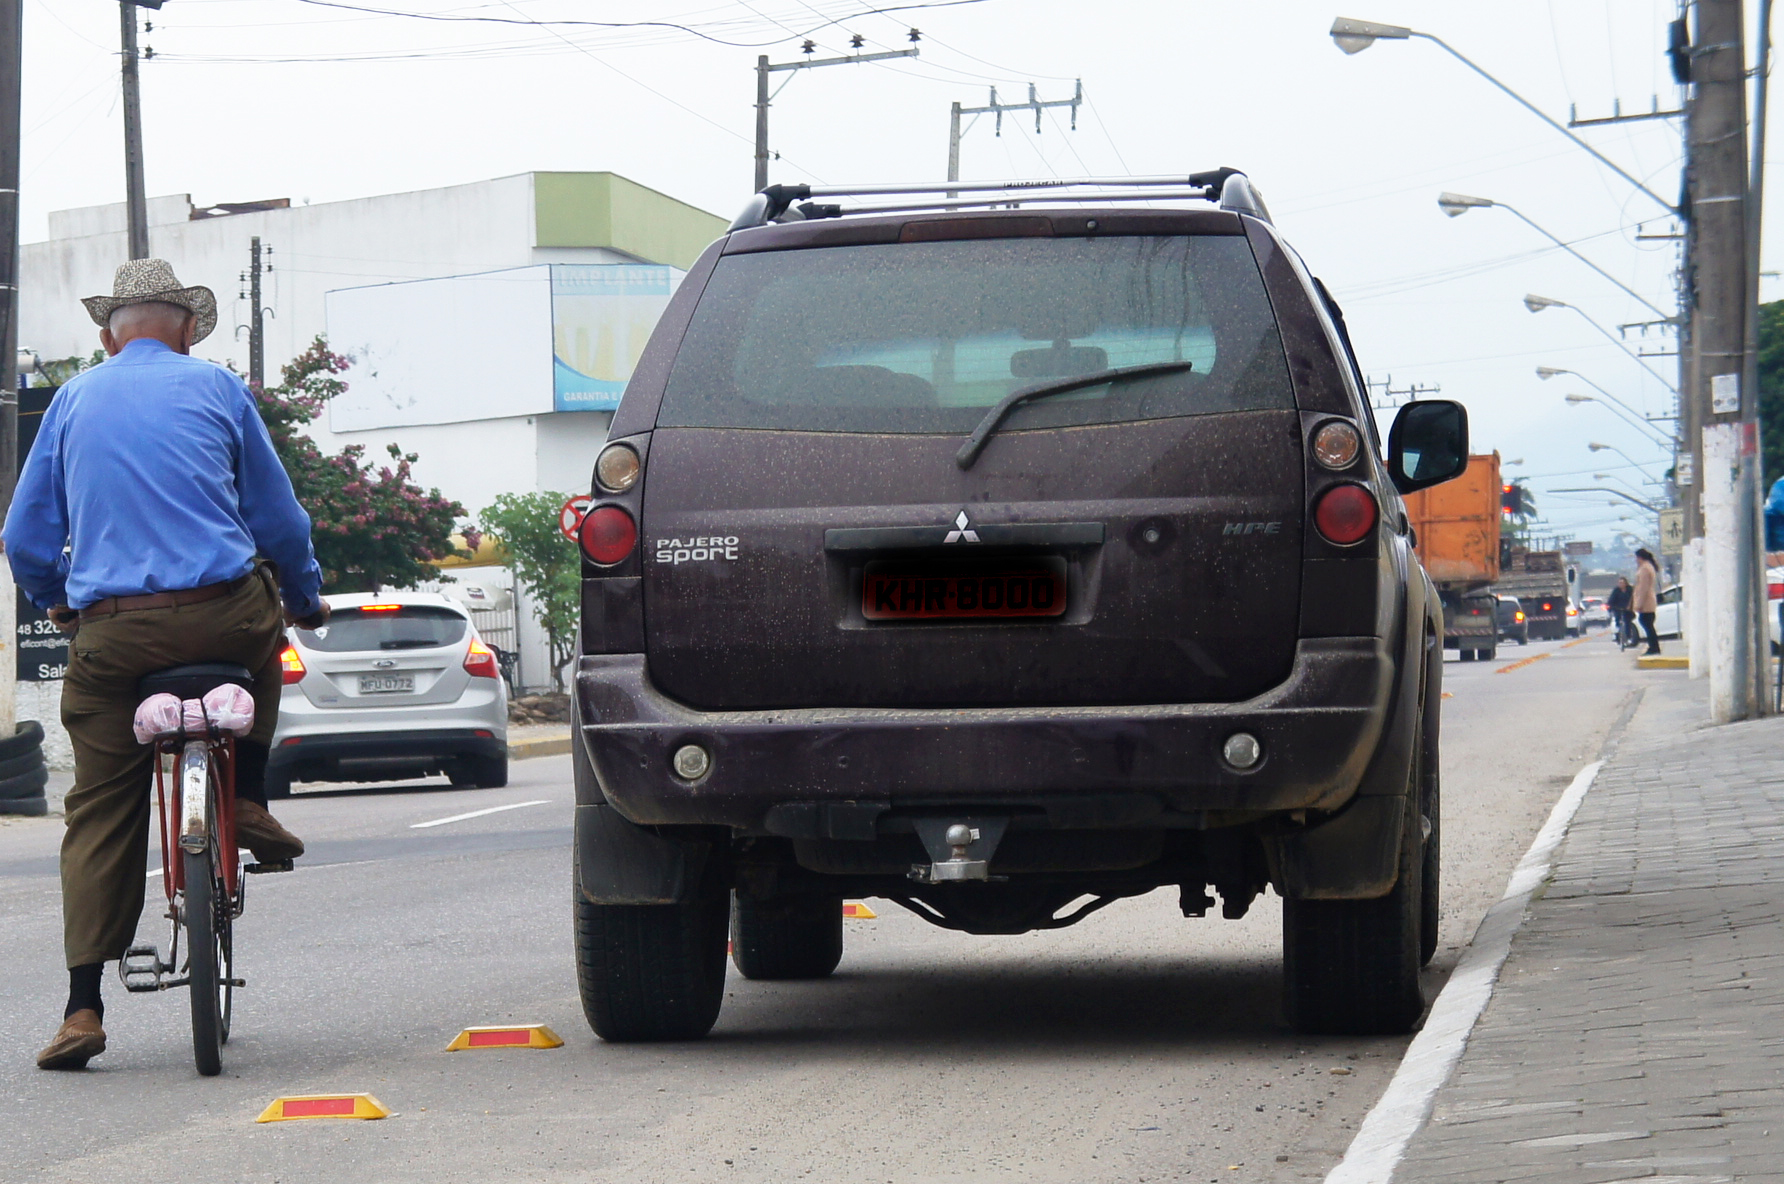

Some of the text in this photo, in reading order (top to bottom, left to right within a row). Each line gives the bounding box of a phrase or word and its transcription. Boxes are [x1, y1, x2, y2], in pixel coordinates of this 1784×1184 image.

[560, 269, 665, 287] IMPLANTE
[564, 391, 609, 401] GARANTIA
[1222, 522, 1282, 535] HPE
[657, 536, 739, 549] PAJERO
[656, 547, 739, 565] sport
[17, 624, 32, 635] 48
